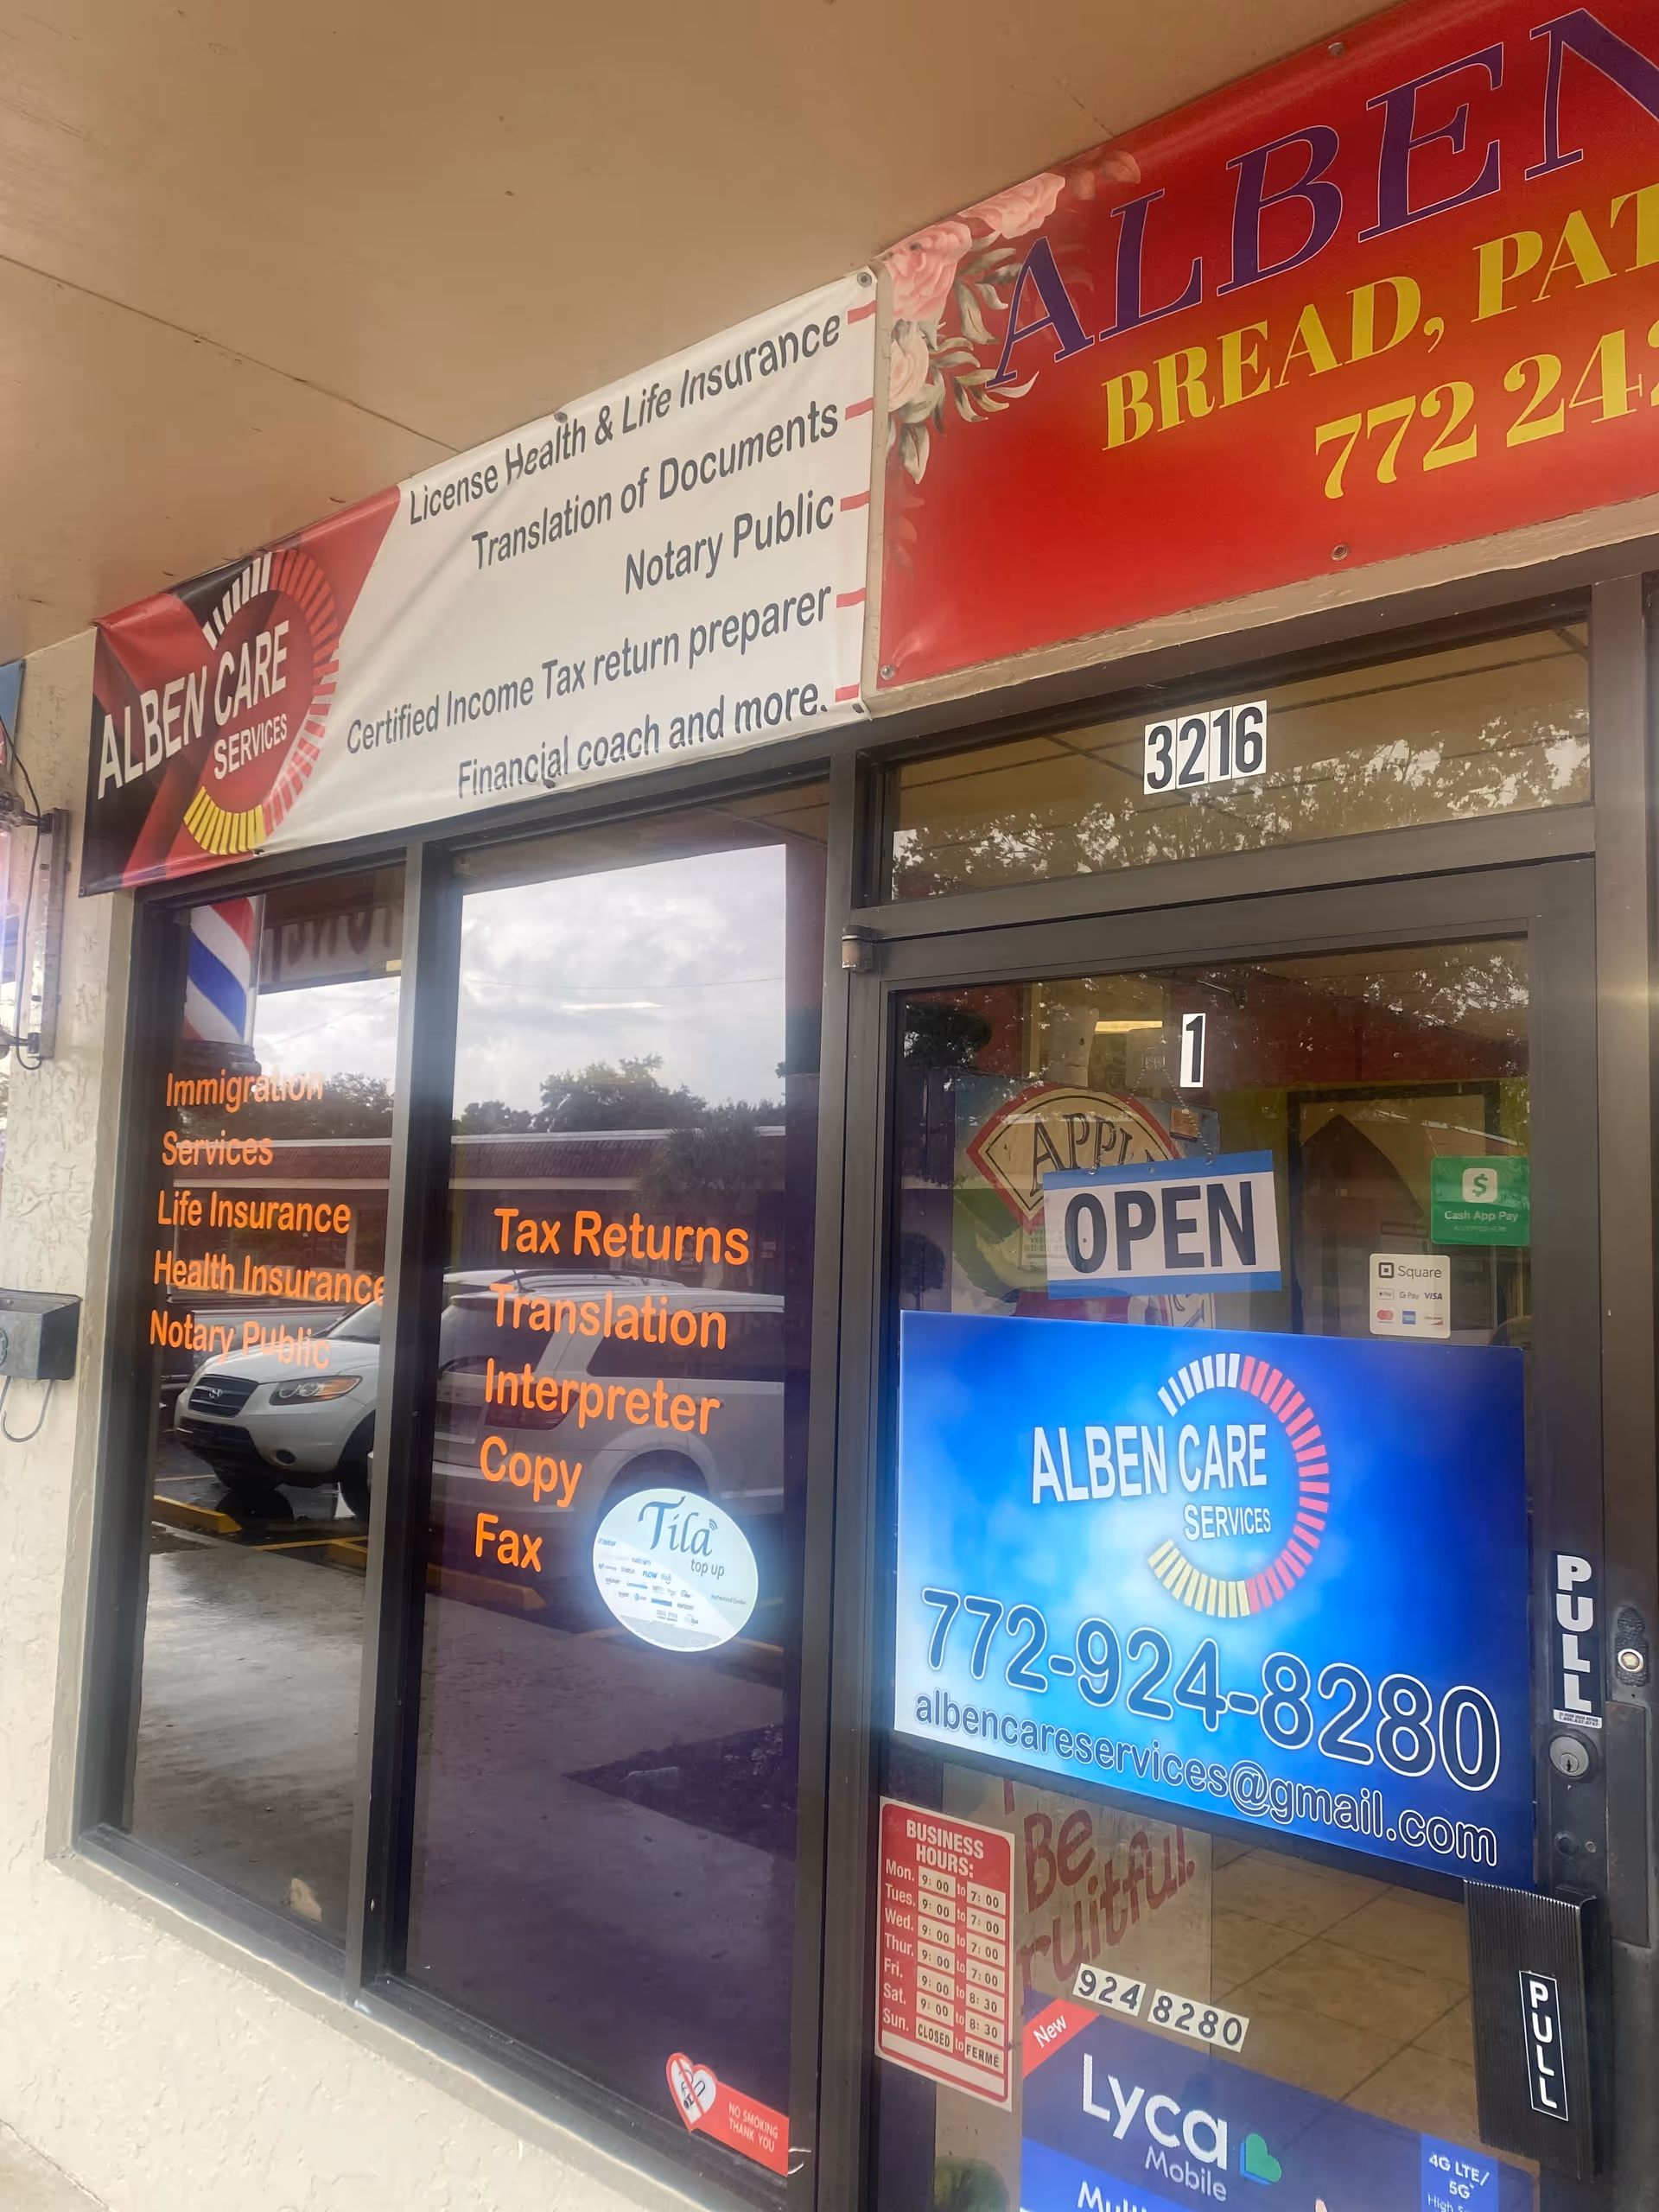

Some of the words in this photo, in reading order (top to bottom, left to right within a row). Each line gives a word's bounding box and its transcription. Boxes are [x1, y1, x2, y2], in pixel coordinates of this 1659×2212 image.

[1103, 273, 1446, 451] BREAD,
[409, 465, 499, 524] License
[505, 417, 586, 486] Health
[594, 404, 614, 447] &
[621, 384, 671, 435] Life
[679, 314, 840, 410] Insurance
[1313, 380, 1479, 499] 772
[1503, 321, 1659, 448] 24
[472, 494, 612, 570] Translation
[620, 465, 648, 513] of
[658, 400, 839, 499] Documents
[625, 533, 723, 594] Notary
[733, 490, 835, 559] Public
[347, 696, 439, 754] Certified
[446, 677, 535, 728] Income
[542, 658, 586, 699] Tax
[593, 632, 680, 687] return
[689, 585, 832, 671] preparer
[97, 665, 208, 800] ALBEN
[214, 620, 290, 727] CARE
[213, 713, 289, 780] SERVICES
[458, 734, 569, 799] Financial
[576, 717, 660, 771] coach
[669, 696, 724, 750] and
[734, 683, 828, 731] more.
[1146, 707, 1264, 790] 3216
[1185, 1015, 1204, 1084] 1
[165, 1070, 324, 1113] Immigration
[162, 1130, 273, 1166] Services
[156, 1190, 203, 1228] Life
[209, 1191, 351, 1235] Insurance
[494, 1207, 561, 1255] Tax
[573, 1210, 749, 1266] Returns
[1064, 1180, 1256, 1274] OPEN
[1444, 1211, 1470, 1220] Cash
[1473, 1211, 1496, 1222] App
[1499, 1211, 1518, 1222] Pay
[153, 1249, 235, 1294] Health
[242, 1261, 385, 1307] Insurance
[1398, 1265, 1442, 1281] Square
[149, 1310, 236, 1363] Notary
[242, 1320, 330, 1370] Public
[489, 1283, 727, 1350] Translation
[485, 1357, 721, 1435] Interpreter
[480, 1436, 582, 1508] Copy
[1033, 1426, 1166, 1504] ALBEN
[1179, 1423, 1268, 1492] CARE
[474, 1512, 543, 1573] Fax
[638, 1495, 714, 1557] Tila
[1184, 1504, 1271, 1541] SERVICES
[642, 1570, 658, 1579] FLOW
[691, 1559, 709, 1577] top
[711, 1564, 725, 1580] up
[1556, 1554, 1593, 1713] PULL
[921, 1587, 1501, 1793] 772-924-8280
[914, 1689, 1498, 1867] albencareservices@gmail.com
[906, 1819, 984, 1859] BUSINESS
[916, 1842, 974, 1879] HOURS:
[1024, 1809, 1096, 1913] Be
[885, 1882, 916, 1908] Tues.
[957, 1908, 966, 1923] to
[886, 1859, 915, 1882] Mon.
[957, 1883, 966, 1897] to
[885, 1907, 914, 1932] Wed.
[957, 1933, 966, 1948] to
[885, 1932, 914, 1957] Thur.
[957, 1959, 966, 1974] to
[883, 1982, 906, 2005] Sat.
[956, 2011, 965, 2026] to
[884, 1957, 904, 1979] Fri.
[956, 1985, 965, 2000] to
[1078, 1969, 1141, 2011] 924
[1153, 1995, 1243, 2046] 8280
[882, 2007, 909, 2031] Sun.
[918, 2023, 950, 2049] CLOSED
[955, 2037, 964, 2052] to
[965, 2044, 1000, 2069] FERMÉ
[1033, 2014, 1068, 2049] New
[1529, 1980, 1558, 2108] PULL
[728, 2102, 741, 2118] NO
[742, 2110, 779, 2139] SMOKING
[728, 2118, 754, 2143] THANK
[758, 2133, 775, 2152] YOU
[1083, 2052, 1228, 2171] Lyca
[1144, 2145, 1227, 2202] Mobile
[1428, 2152, 1451, 2171] 4G
